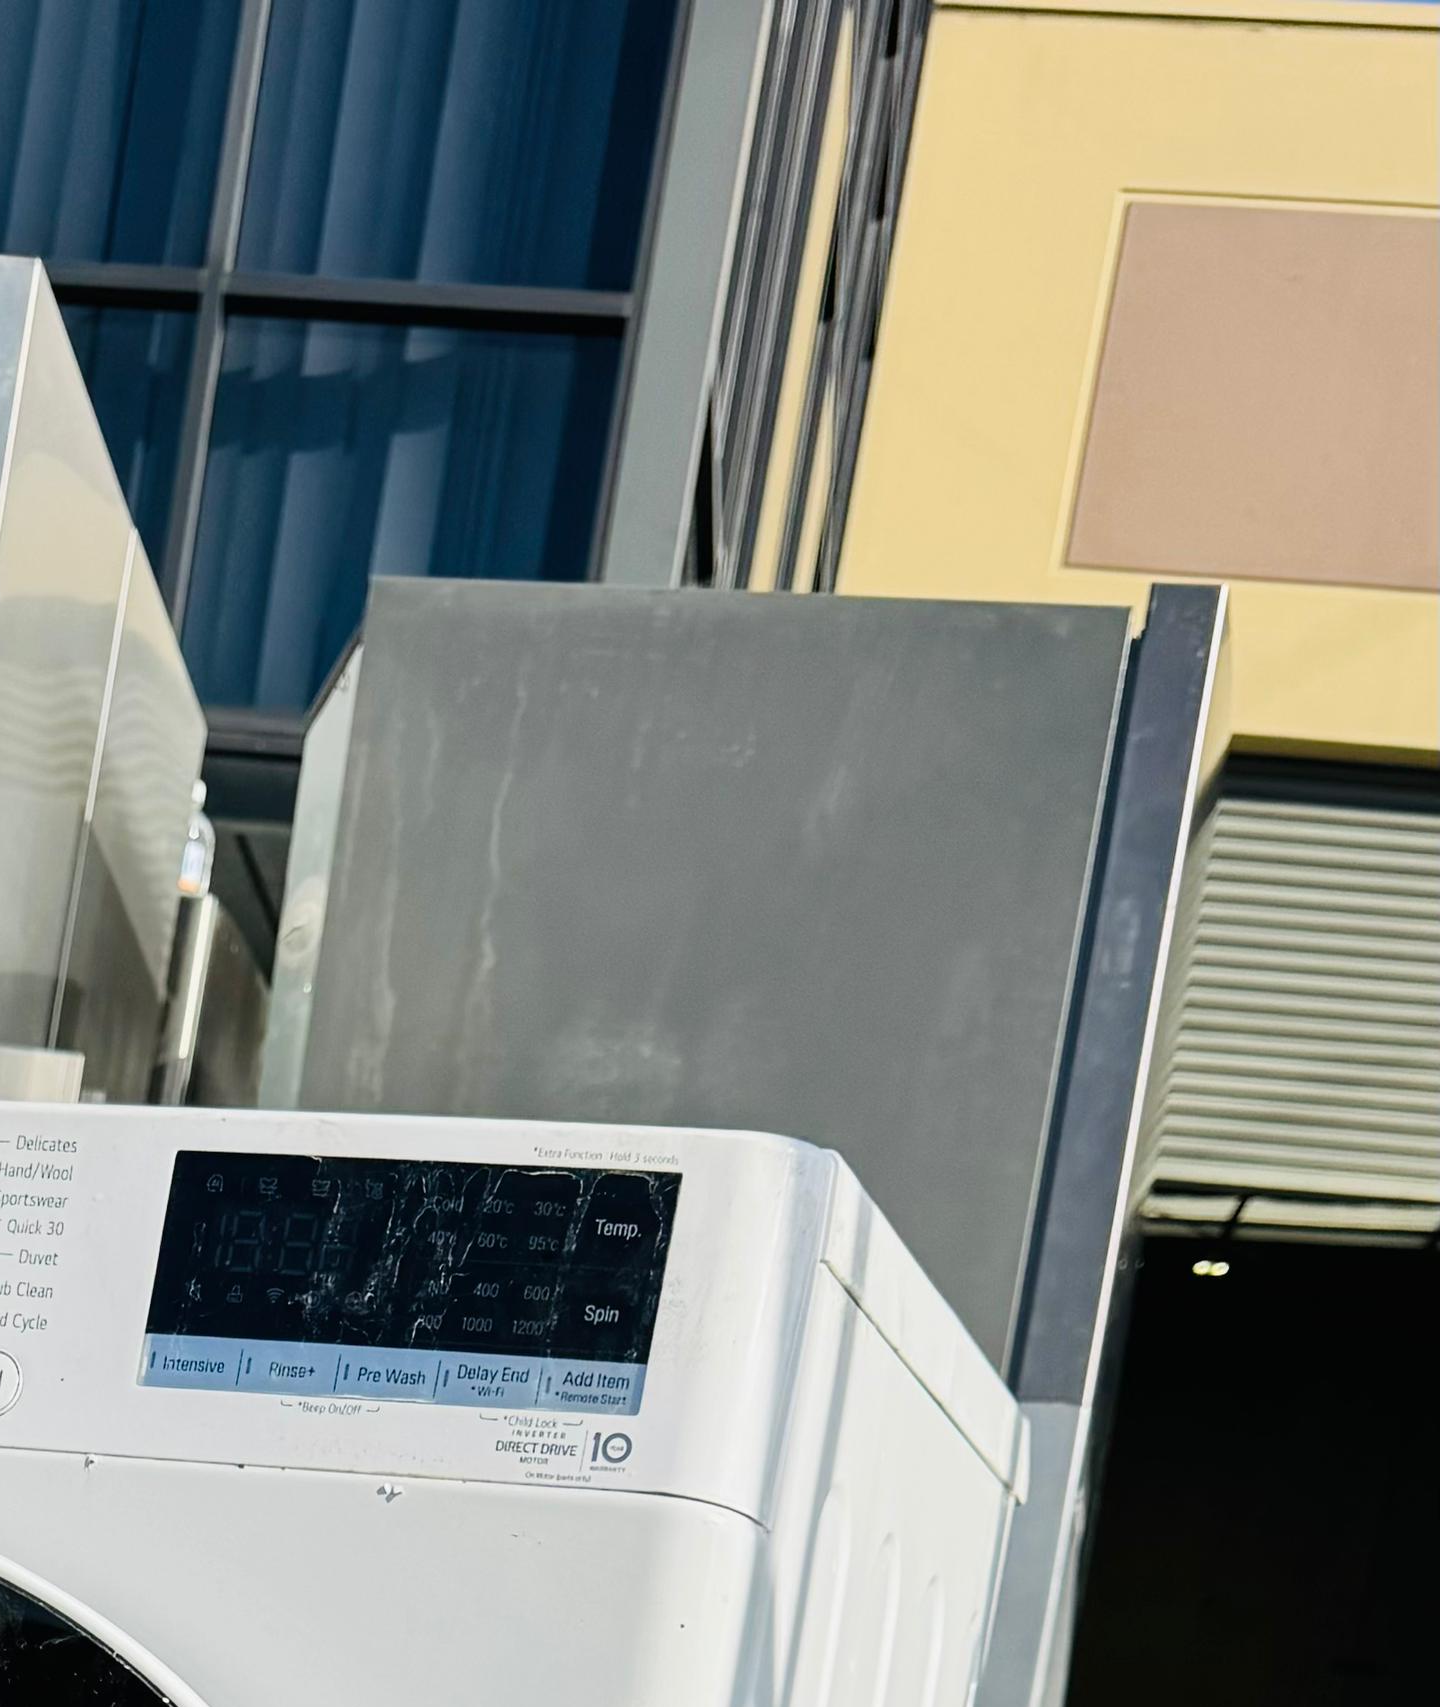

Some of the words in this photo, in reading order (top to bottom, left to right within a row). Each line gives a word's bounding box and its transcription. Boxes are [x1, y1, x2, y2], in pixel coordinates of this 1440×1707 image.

[16, 1135, 78, 1153] Delicates
[7, 1218, 43, 1235] Quick
[46, 1220, 65, 1236] 30
[595, 1219, 642, 1239] Temp.
[18, 1248, 59, 1267] Duvet
[16, 1281, 54, 1299] Clean
[12, 1312, 48, 1333] Cycle
[583, 1304, 620, 1326] Spin
[461, 1316, 493, 1333] 1000
[512, 1319, 544, 1336] 1200
[162, 1355, 225, 1374] Intensive
[269, 1361, 316, 1379] Rinse+
[357, 1366, 382, 1383] Pre
[385, 1368, 426, 1386] Wash
[457, 1364, 499, 1385] Delay
[501, 1367, 531, 1384] End
[562, 1371, 593, 1389] Add
[596, 1373, 630, 1390] Item
[535, 1416, 558, 1429] Lock
[495, 1440, 539, 1455] DIRECT
[540, 1442, 578, 1457] DRIVE
[591, 1431, 633, 1464] 10
